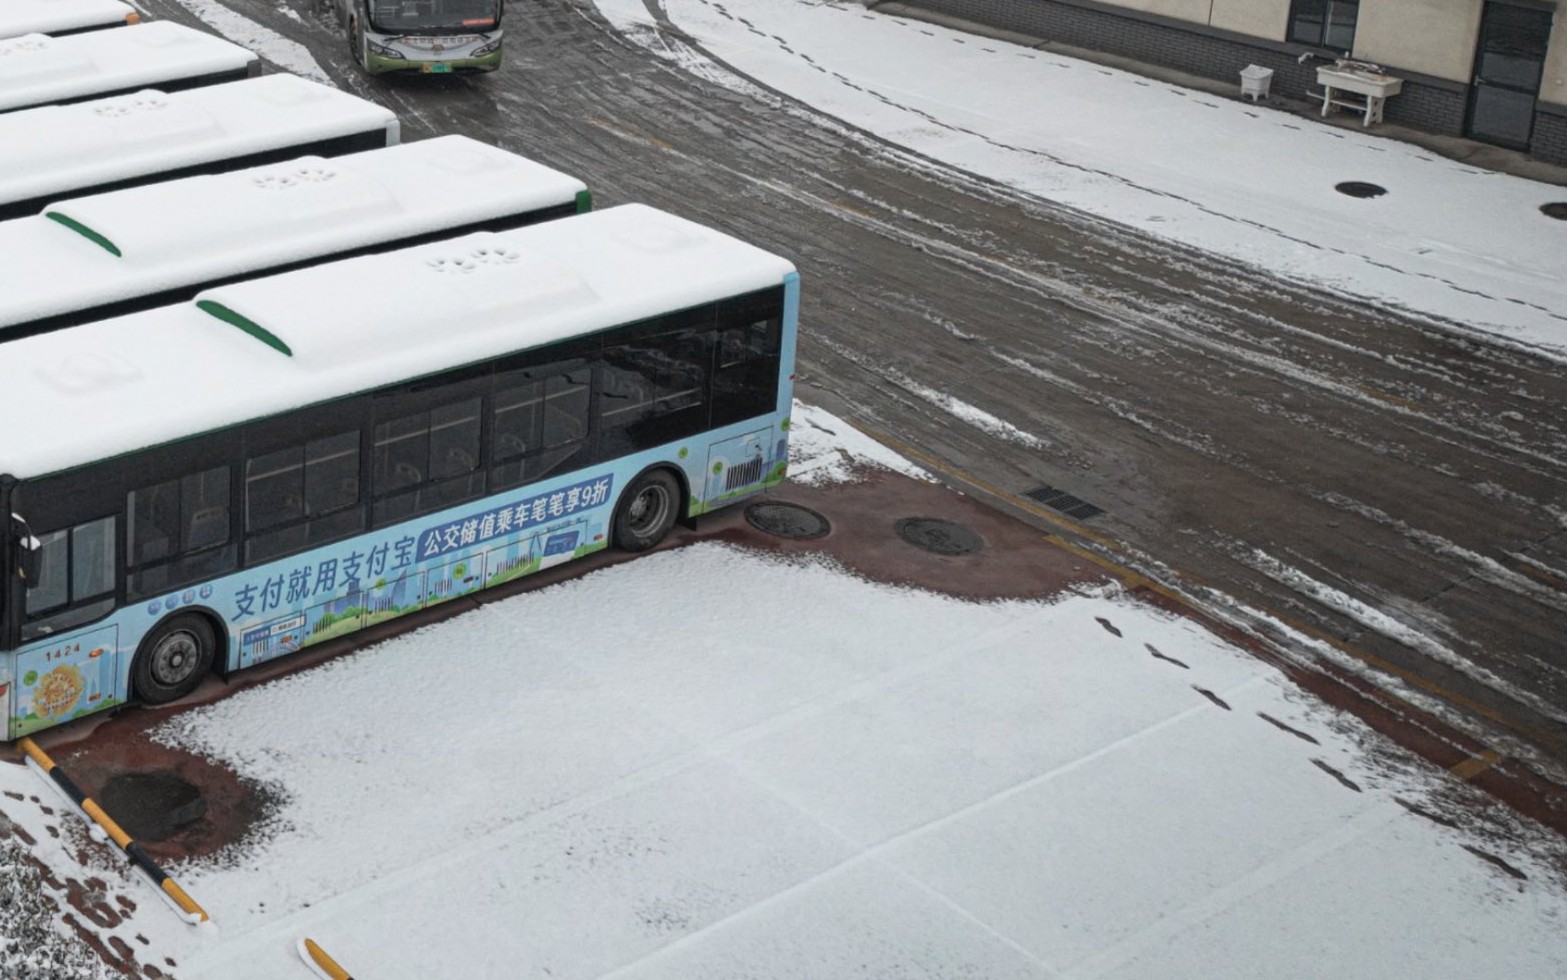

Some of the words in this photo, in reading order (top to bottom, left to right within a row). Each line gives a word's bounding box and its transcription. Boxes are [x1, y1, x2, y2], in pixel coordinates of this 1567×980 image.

[231, 535, 415, 622] 支付就用支付宝
[424, 477, 609, 557] 公交储值乘车笔笔享9折
[45, 643, 80, 662] 1424
